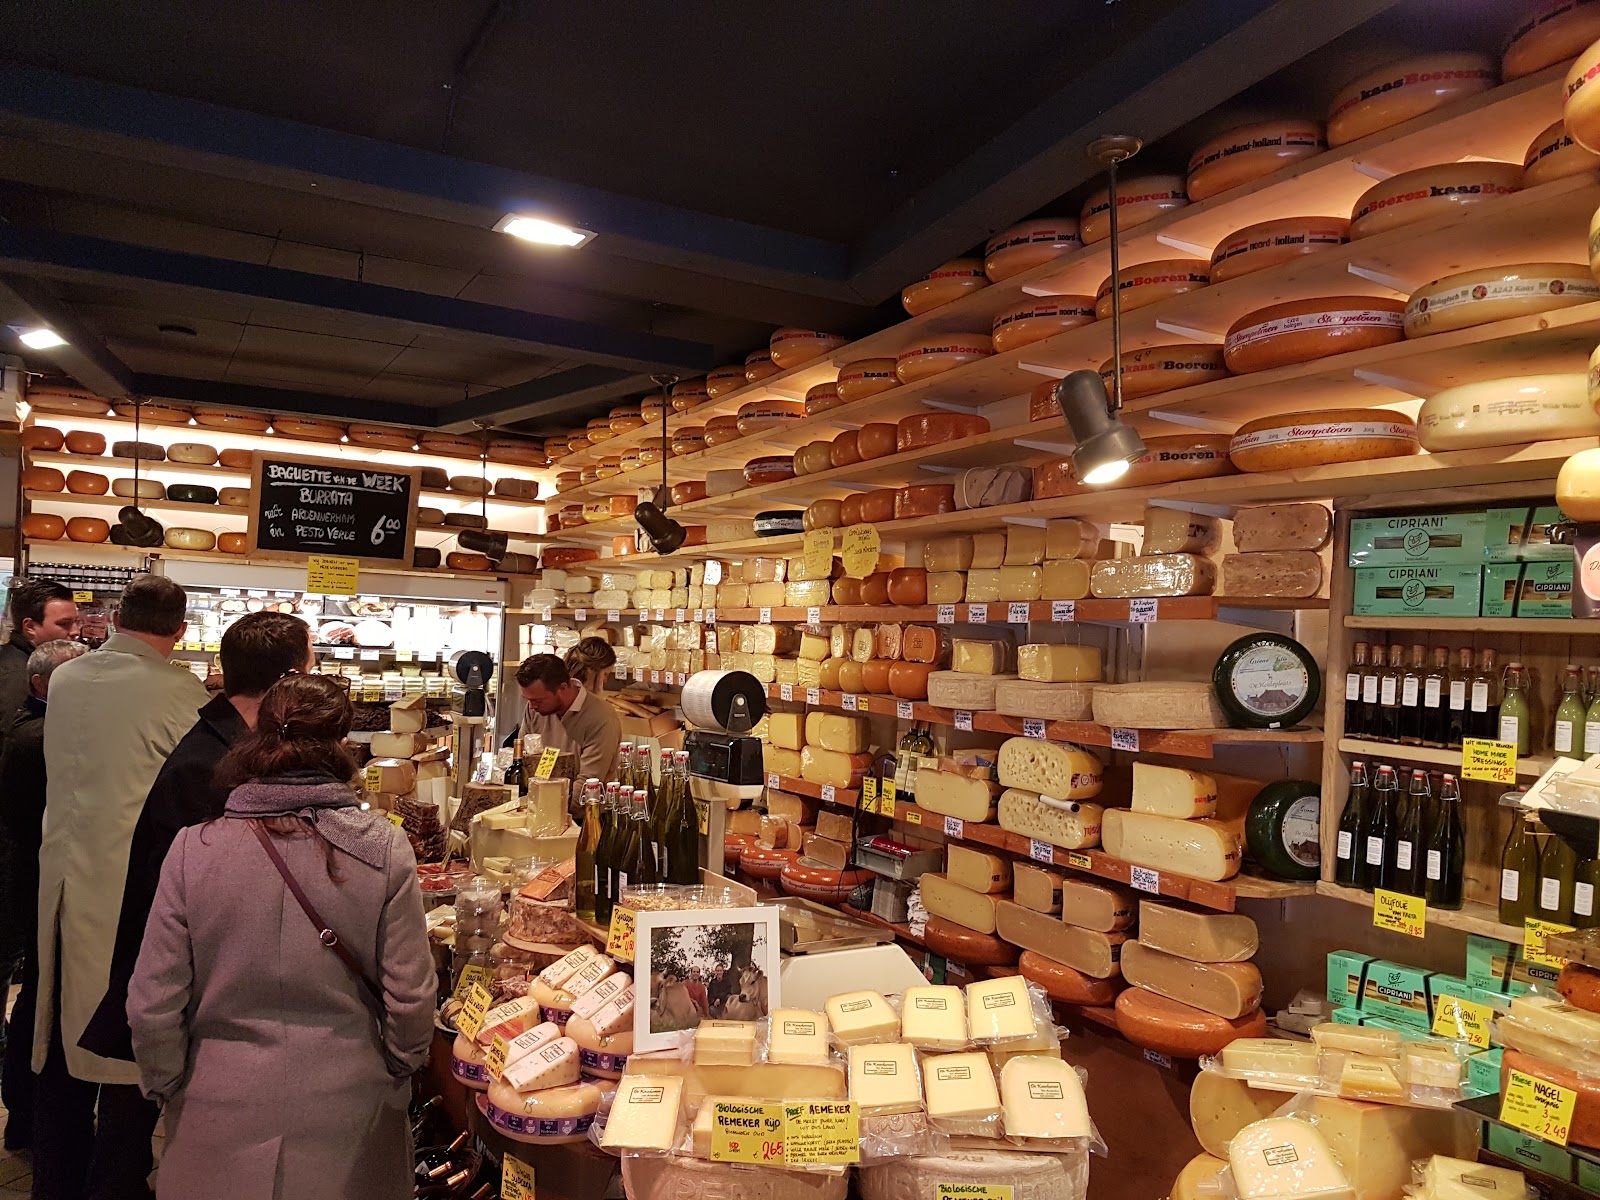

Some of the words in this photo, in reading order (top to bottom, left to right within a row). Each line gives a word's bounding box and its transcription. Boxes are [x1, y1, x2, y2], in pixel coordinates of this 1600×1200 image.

[1360, 78, 1403, 101] kaas
[1117, 191, 1170, 206] Boeren
[1369, 190, 1428, 212] Boeren
[1429, 184, 1481, 198] kaas
[930, 271, 972, 279] Boeren
[1134, 274, 1188, 287] Boeren
[1126, 360, 1155, 372] kaas
[1164, 360, 1217, 371] Boeren
[1287, 424, 1352, 438] Stompetoren
[1159, 451, 1215, 461] Boeren
[267, 465, 332, 483] BAGUETTE
[362, 472, 406, 493] WEEK
[299, 487, 354, 506] BURRATA
[1387, 516, 1444, 529] CIPRIANI
[295, 525, 325, 538] PESTO
[327, 526, 356, 541] VERDE
[1388, 568, 1439, 579] CIPRIANI
[1472, 749, 1489, 757] HOME
[1470, 756, 1508, 767] DRESSINGS
[1529, 969, 1559, 980] CIPRIA
[1379, 986, 1412, 1000] CIPRIANI
[1534, 1081, 1564, 1103] NAGEL
[809, 1104, 851, 1115] REMEKER
[718, 1115, 760, 1128] REMEKER
[1543, 1122, 1567, 1140] 2.49
